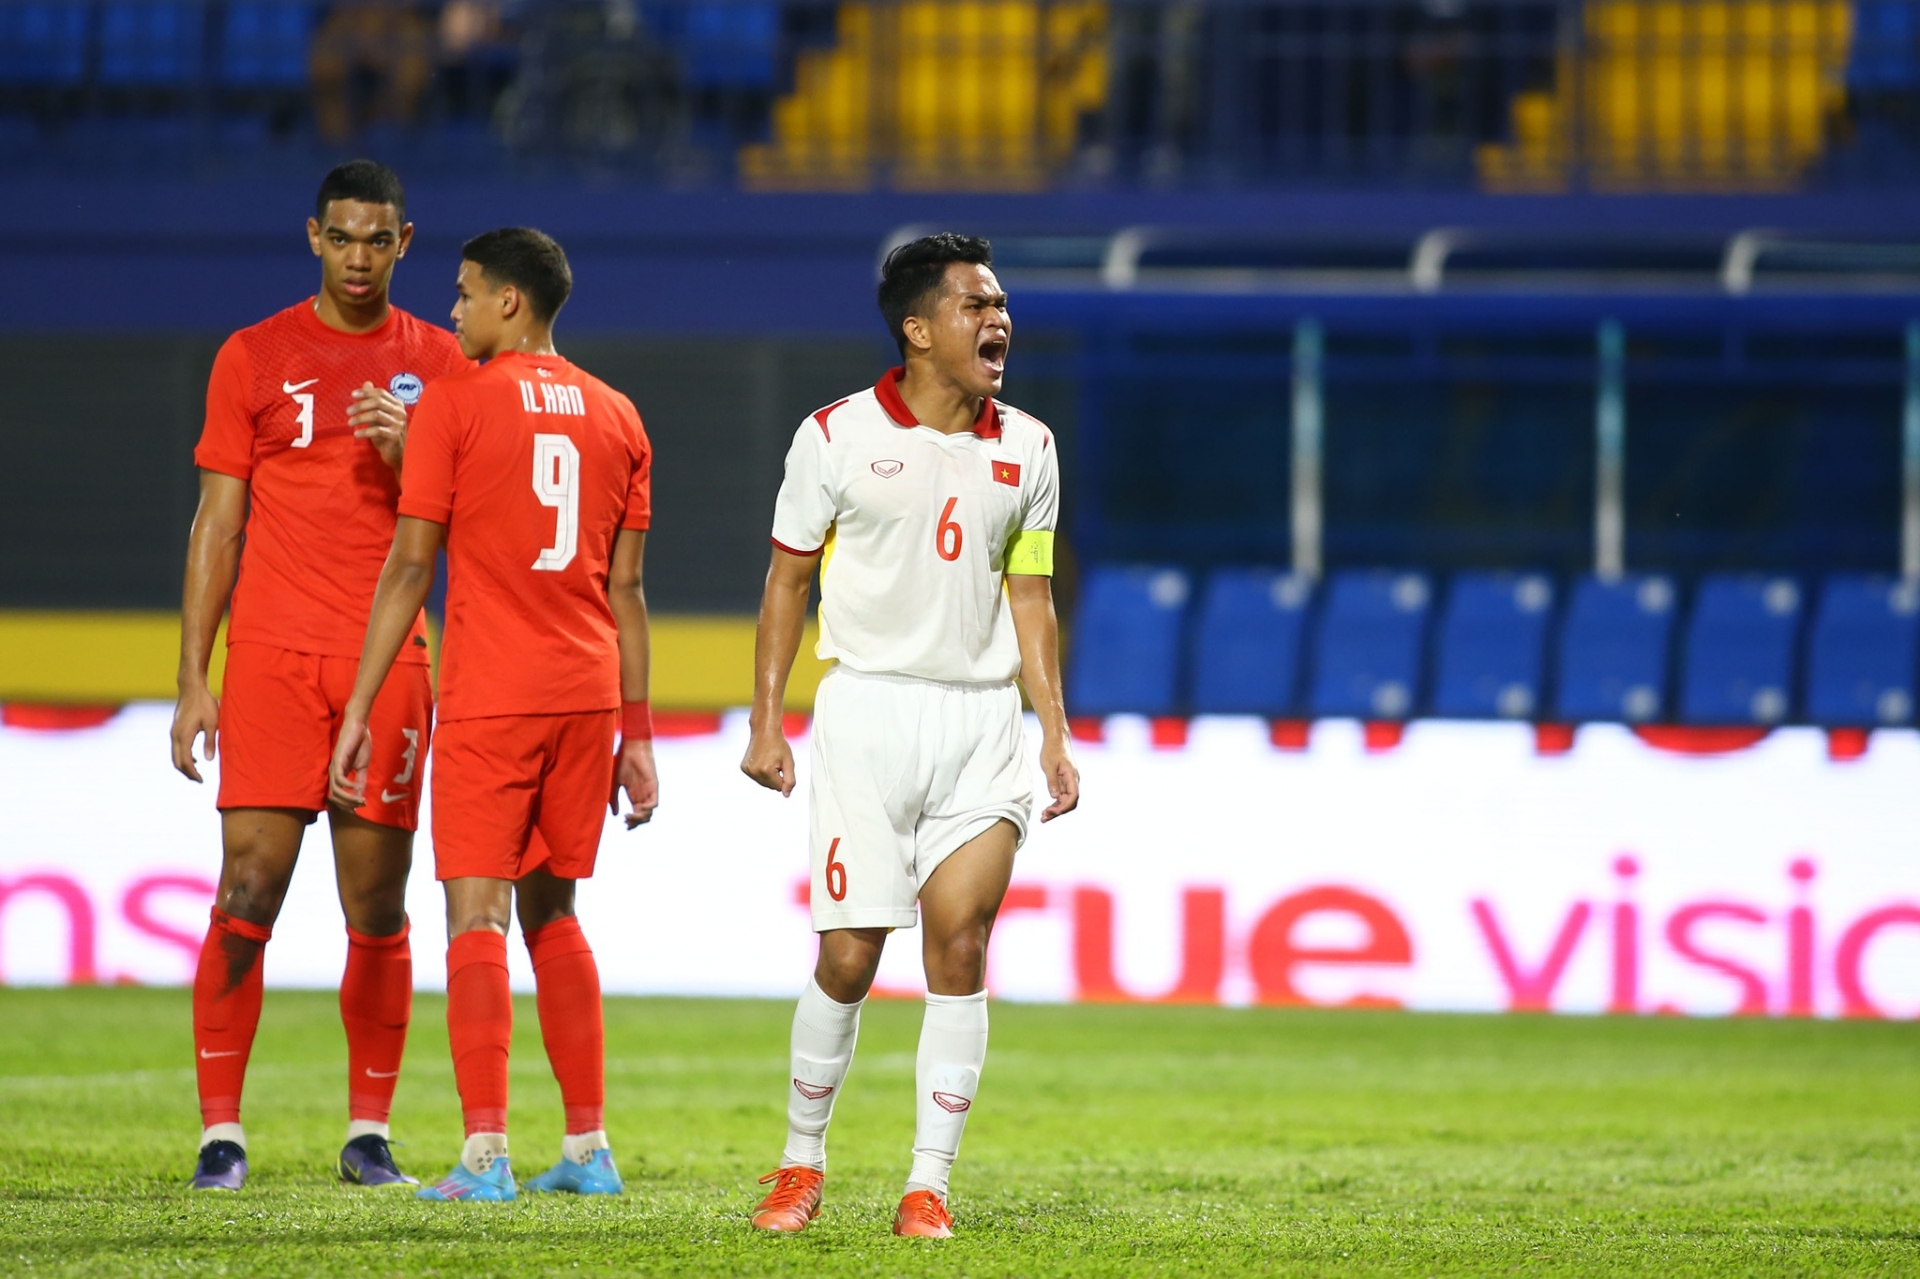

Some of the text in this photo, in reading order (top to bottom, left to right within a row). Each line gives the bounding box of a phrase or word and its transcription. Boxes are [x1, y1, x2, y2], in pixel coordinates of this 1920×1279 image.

[290, 393, 314, 448] 3
[519, 379, 586, 416] ILHAN
[531, 433, 580, 571] 9
[935, 496, 963, 562] 6
[393, 727, 418, 785] 3
[825, 837, 847, 902] 6
[794, 882, 1414, 1009] ue
